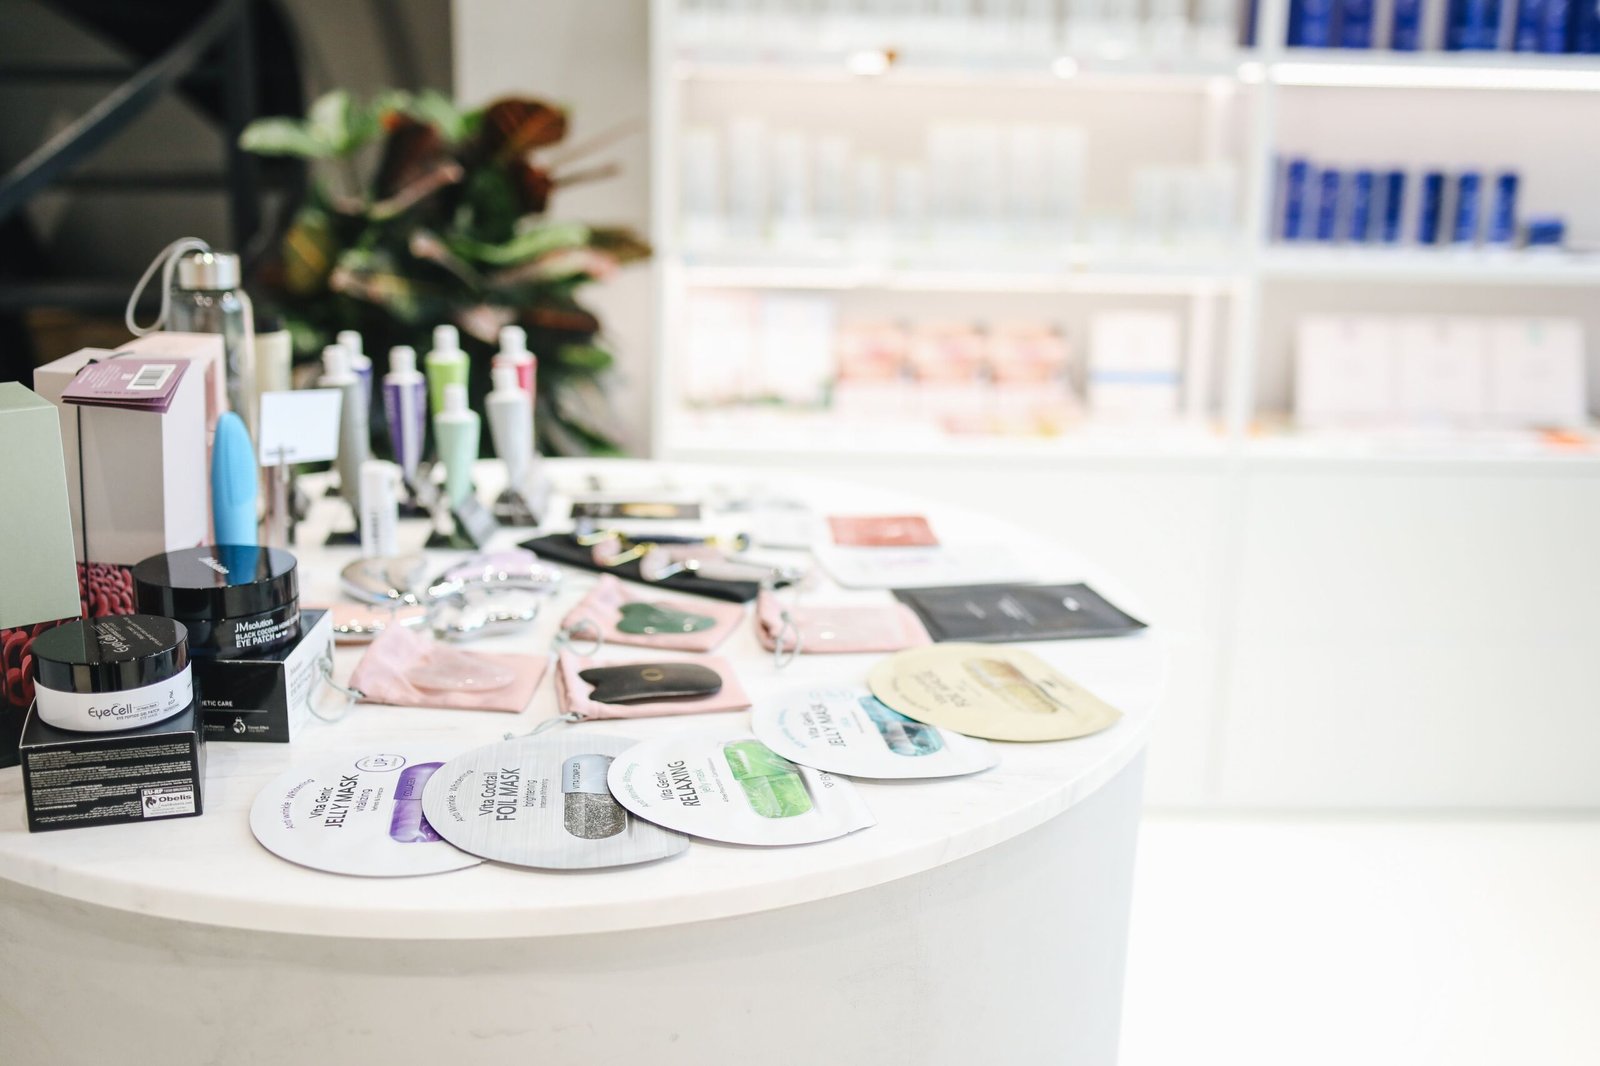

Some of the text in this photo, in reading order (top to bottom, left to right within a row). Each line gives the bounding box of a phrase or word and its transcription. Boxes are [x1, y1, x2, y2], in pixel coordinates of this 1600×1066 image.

[234, 618, 274, 633] JMsolution
[236, 632, 256, 640] BLACK
[257, 625, 278, 635] COCOON
[236, 634, 275, 648] EYE PATCH
[88, 704, 132, 720] EyeCell
[479, 772, 498, 816] Vita Cocktail
[496, 768, 520, 821] FOIL MASK
[523, 780, 537, 808] brightening
[654, 772, 674, 800] Vita Genic
[668, 760, 701, 806] RELAXING
[159, 794, 192, 802] Obelis
[309, 787, 333, 819] Vita Genic
[324, 774, 359, 828] JELLY MASK
[356, 788, 372, 812] vitalizing
